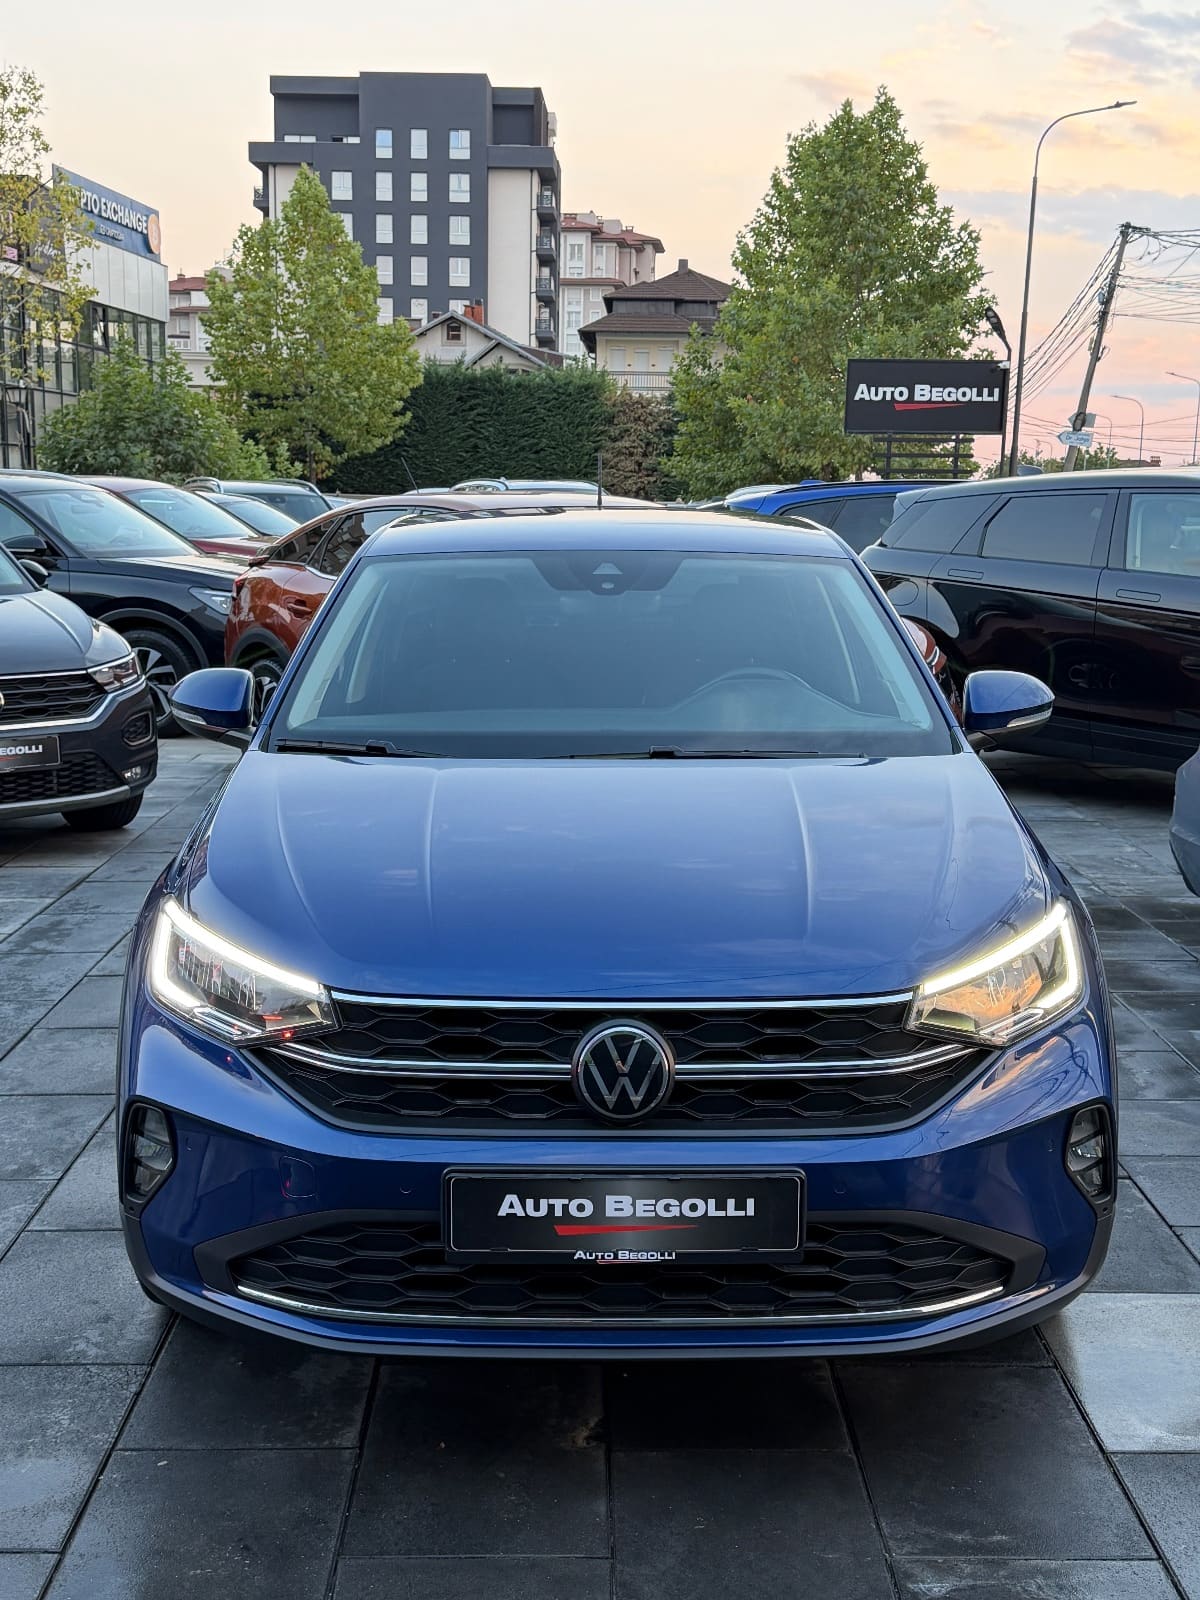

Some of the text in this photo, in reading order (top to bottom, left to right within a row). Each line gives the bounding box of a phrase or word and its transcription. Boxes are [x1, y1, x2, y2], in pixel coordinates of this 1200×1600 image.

[101, 195, 148, 235] EXCHANGE
[853, 383, 1000, 402] AUTO BEGOLLI
[0, 744, 43, 756] EGOLLI
[497, 1194, 755, 1218] AUTO BEGOLLI
[573, 1250, 676, 1260] AUTO BEGOLLI
